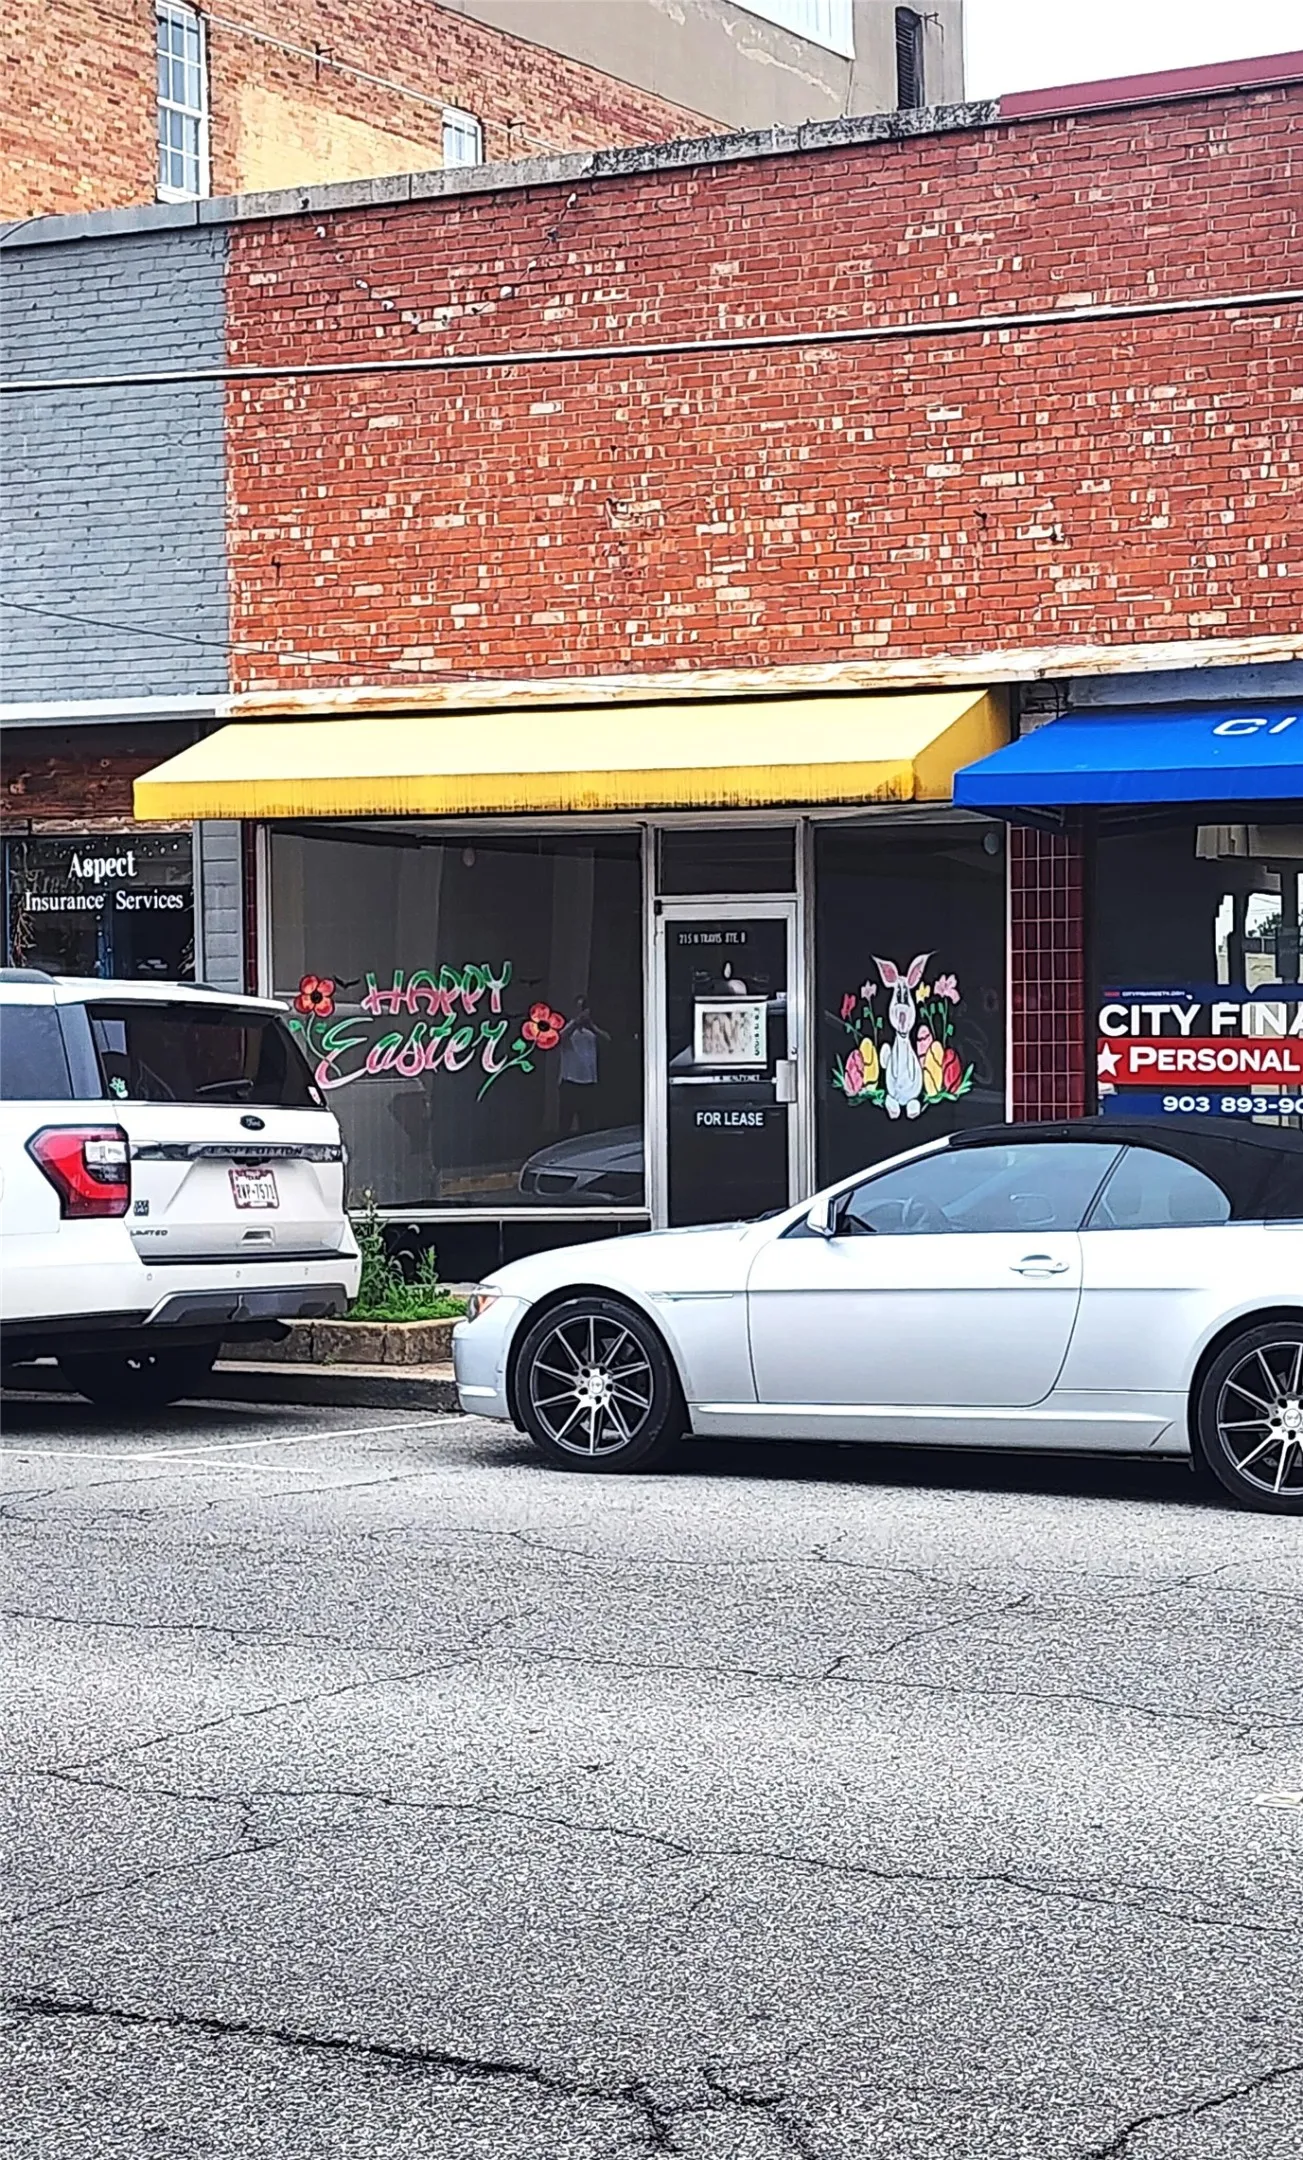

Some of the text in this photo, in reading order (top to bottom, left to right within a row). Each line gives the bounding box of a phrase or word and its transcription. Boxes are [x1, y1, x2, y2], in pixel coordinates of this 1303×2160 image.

[67, 850, 138, 884] Aspect
[25, 890, 184, 911] Insurance Services
[679, 933, 692, 944] 215
[360, 960, 513, 1015] HAPPY
[1098, 1003, 1201, 1036] CITY
[314, 1013, 509, 1090] Easter
[1129, 1046, 1301, 1072] PERSONAL
[1162, 1096, 1210, 1112] 903
[696, 1112, 764, 1126] FOR LEASE
[130, 1229, 168, 1237] LIMITED
